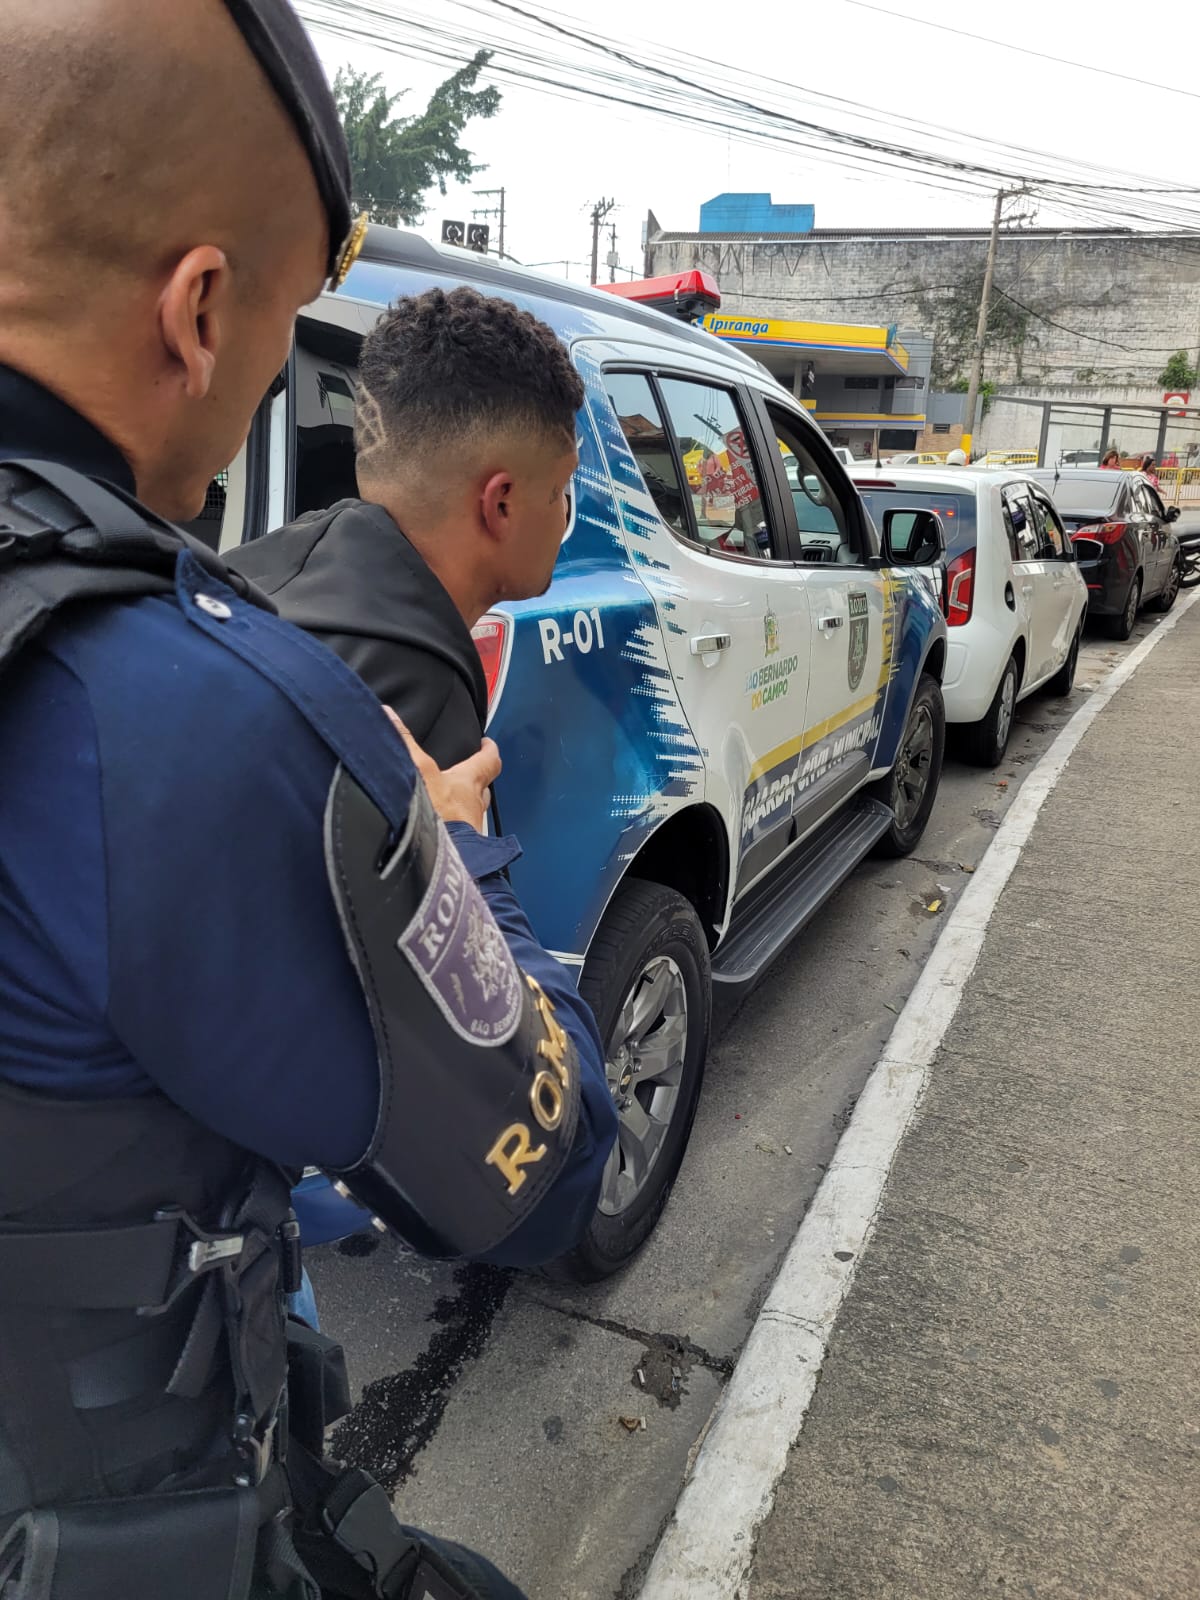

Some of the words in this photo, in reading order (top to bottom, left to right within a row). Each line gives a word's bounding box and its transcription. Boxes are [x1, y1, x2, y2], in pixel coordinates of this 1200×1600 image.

[710, 317, 769, 336] Ipiranga
[538, 607, 605, 665] R-01
[759, 655, 798, 687] BERNARDO
[752, 690, 762, 711] DO
[763, 679, 788, 705] CAMPO
[742, 767, 799, 838] GUARDA
